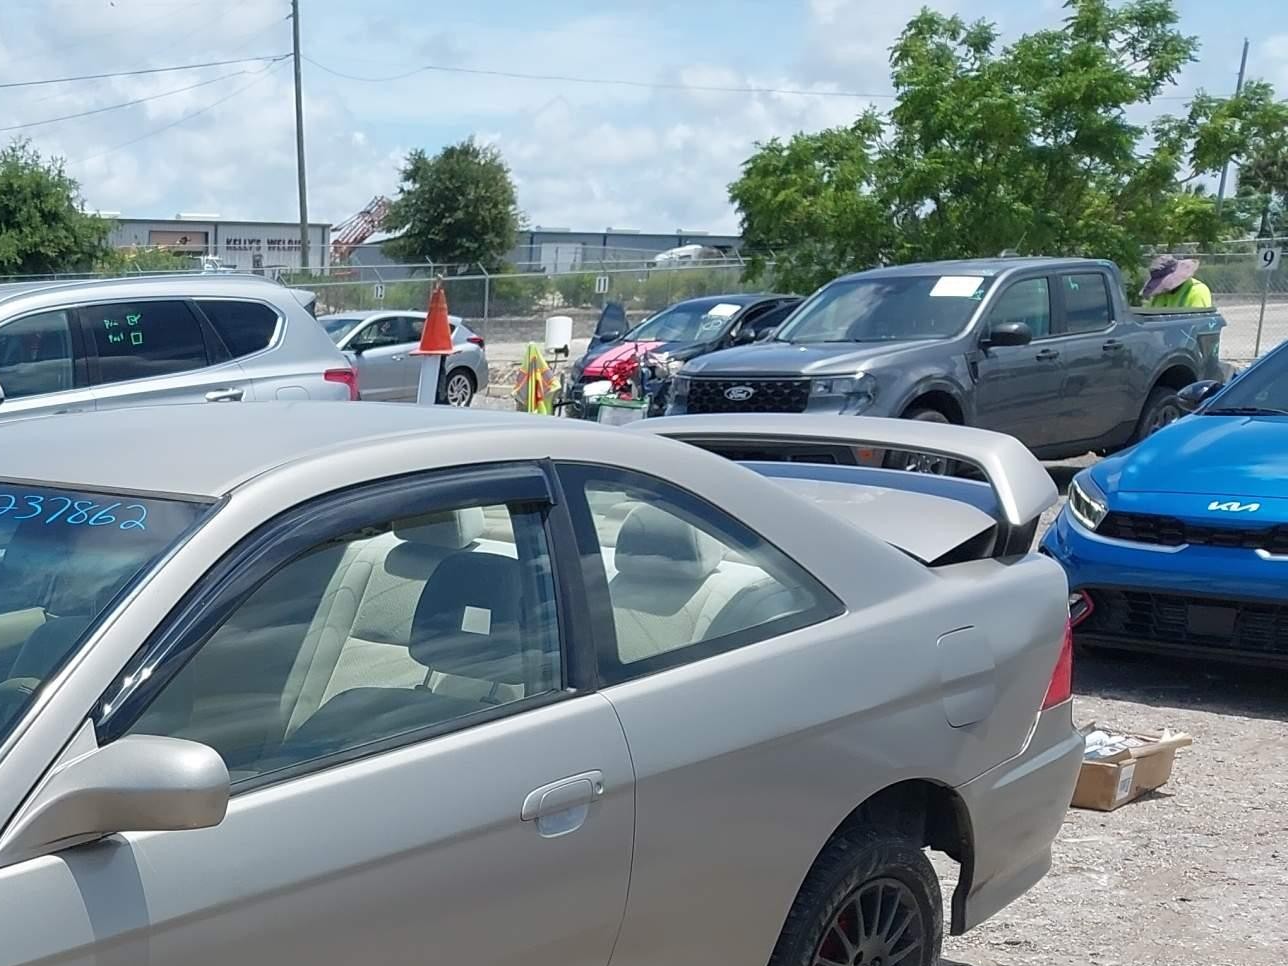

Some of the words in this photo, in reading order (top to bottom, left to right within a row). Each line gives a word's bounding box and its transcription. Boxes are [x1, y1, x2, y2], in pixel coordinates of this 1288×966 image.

[1263, 250, 1274, 268] 9
[375, 285, 383, 298] 12
[598, 278, 607, 292] 11
